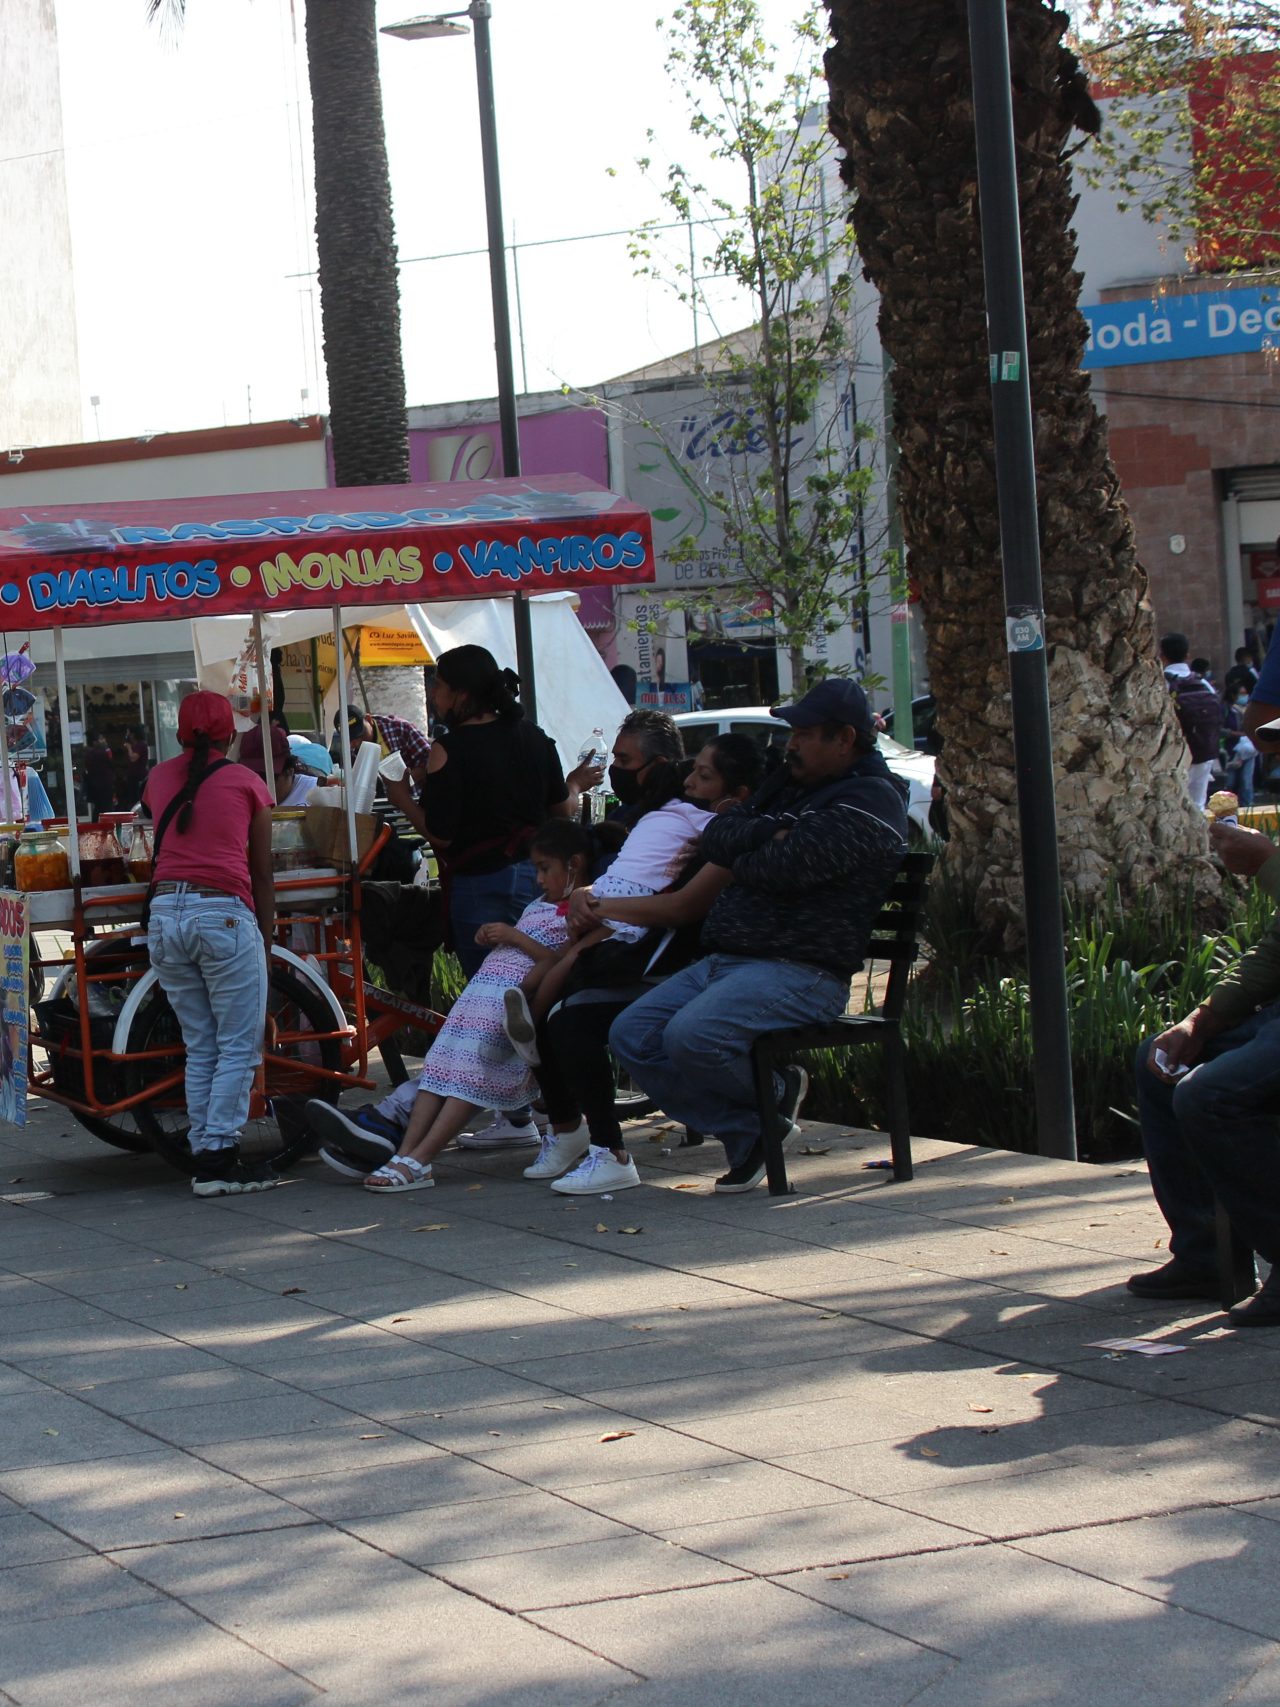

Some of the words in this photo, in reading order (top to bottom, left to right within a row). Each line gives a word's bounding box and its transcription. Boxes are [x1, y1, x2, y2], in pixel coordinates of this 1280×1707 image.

[1086, 312, 1172, 350] oda
[115, 505, 518, 544] RASPADOS
[28, 560, 220, 611] DIABLITOS
[261, 546, 423, 598] MONJAS
[459, 531, 646, 580] VAMPIROS
